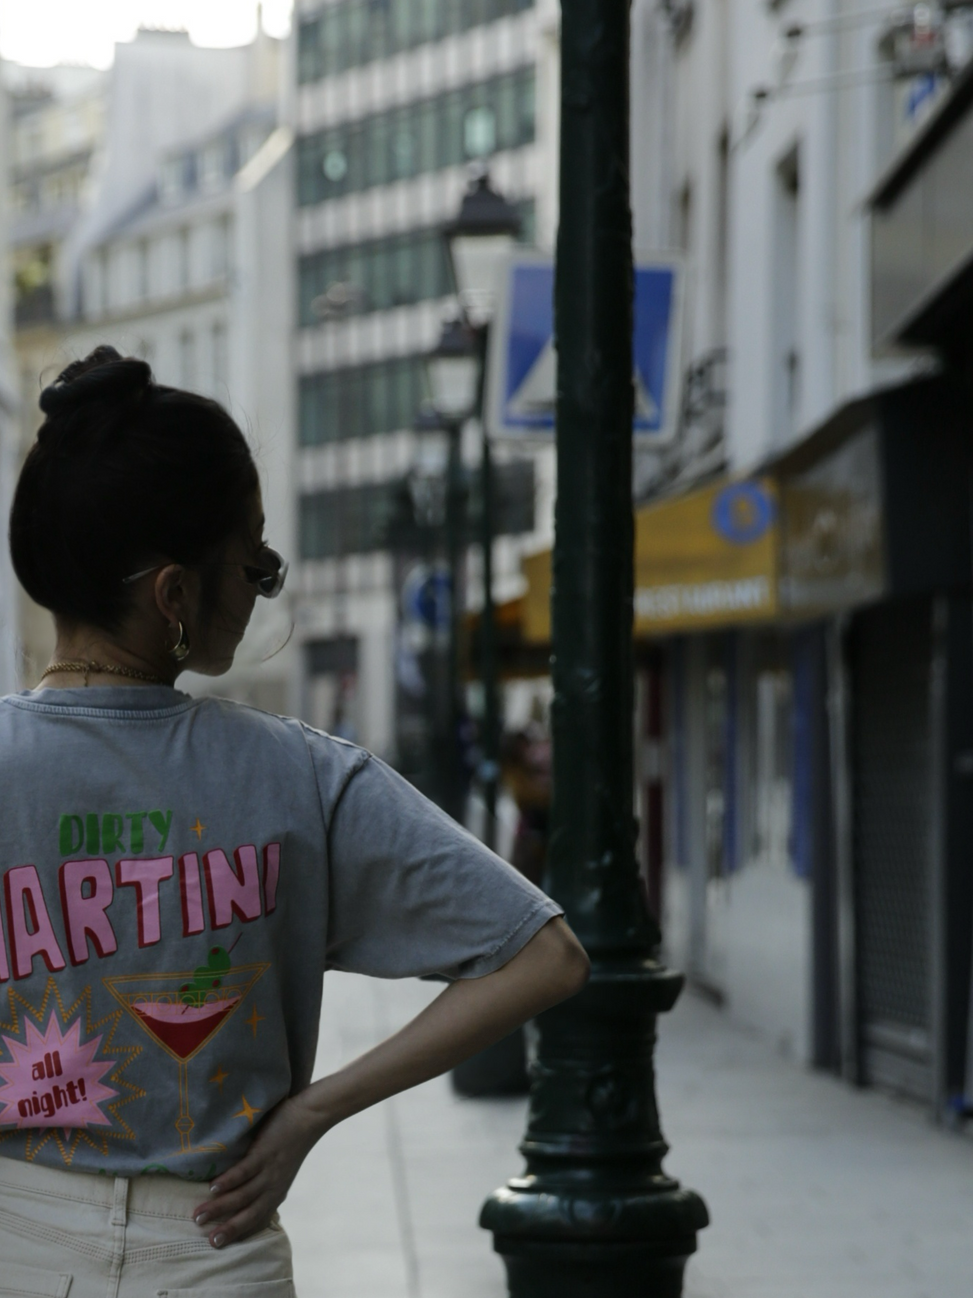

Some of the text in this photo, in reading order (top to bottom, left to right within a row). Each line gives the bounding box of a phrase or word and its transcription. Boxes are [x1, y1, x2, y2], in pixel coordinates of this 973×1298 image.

[59, 810, 172, 856] DIRTY
[31, 1051, 63, 1081] all
[17, 1078, 87, 1118] night!
